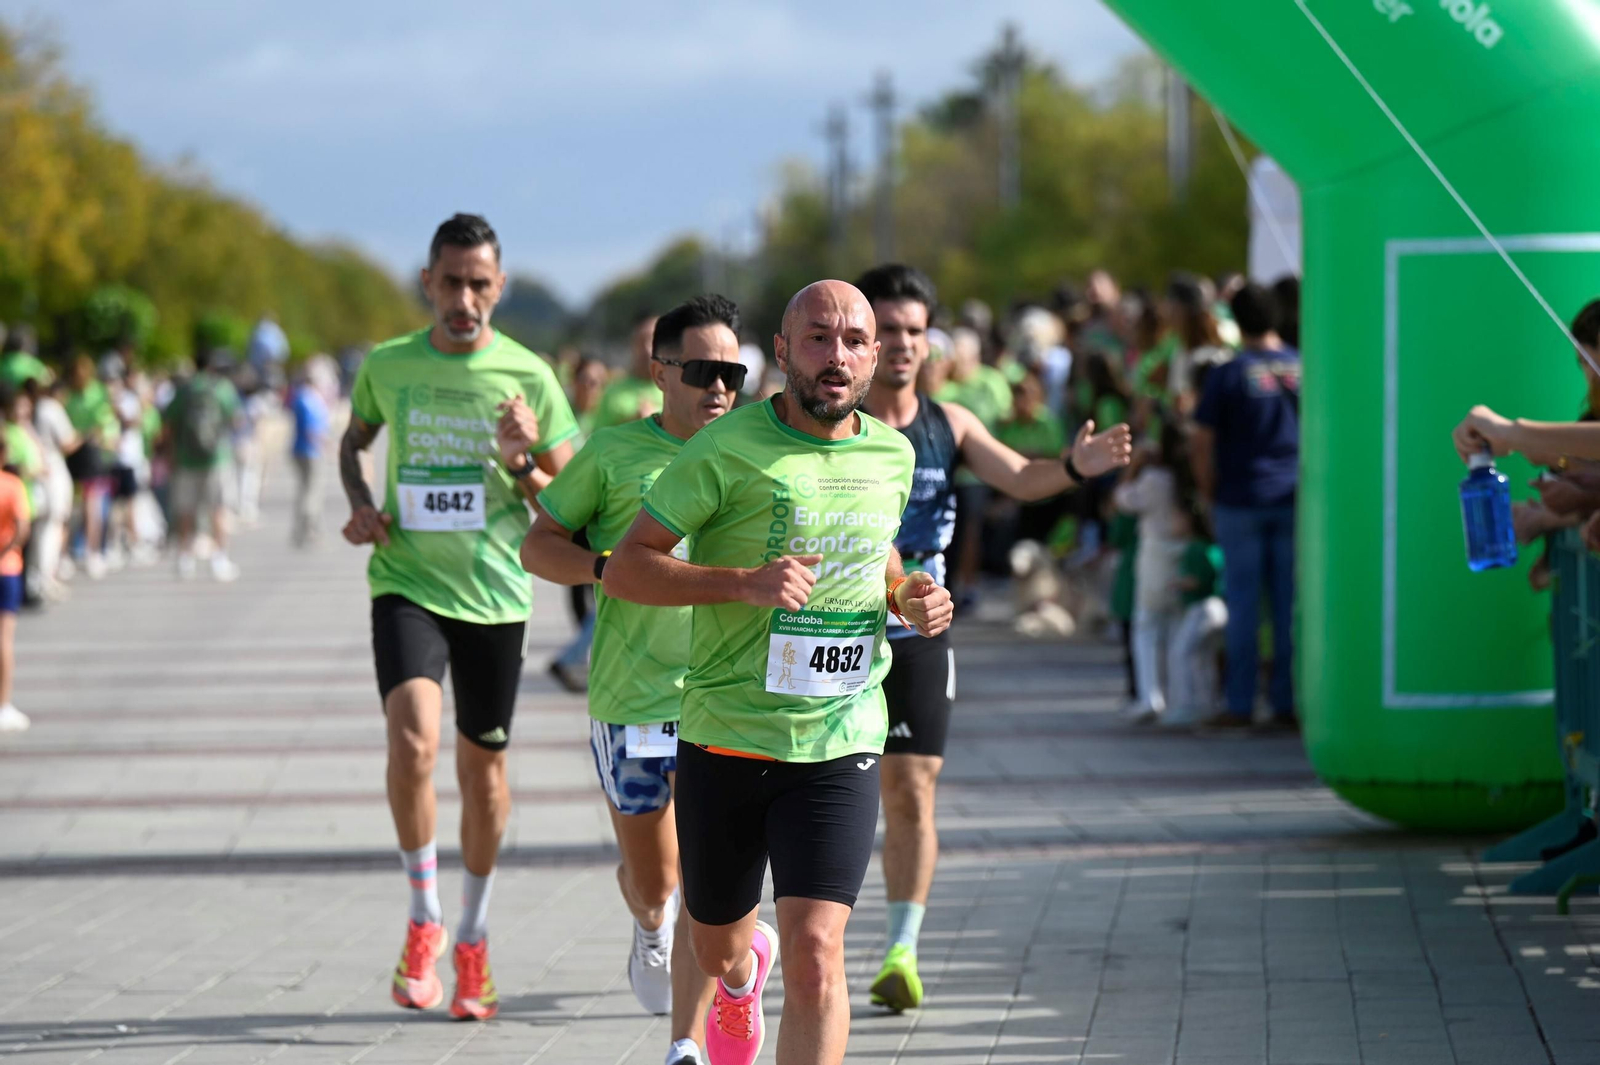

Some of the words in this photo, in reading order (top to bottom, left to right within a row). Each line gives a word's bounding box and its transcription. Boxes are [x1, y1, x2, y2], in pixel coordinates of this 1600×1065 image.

[409, 409, 432, 426] En
[424, 491, 474, 512] 4642
[760, 475, 790, 563] ÓRDOBA
[794, 506, 819, 526] En
[789, 532, 872, 554] contra
[876, 540, 890, 556] e
[810, 560, 878, 582] ance
[824, 597, 854, 607] ERMITA
[779, 613, 823, 625] Córdoba
[809, 644, 864, 673] 4832
